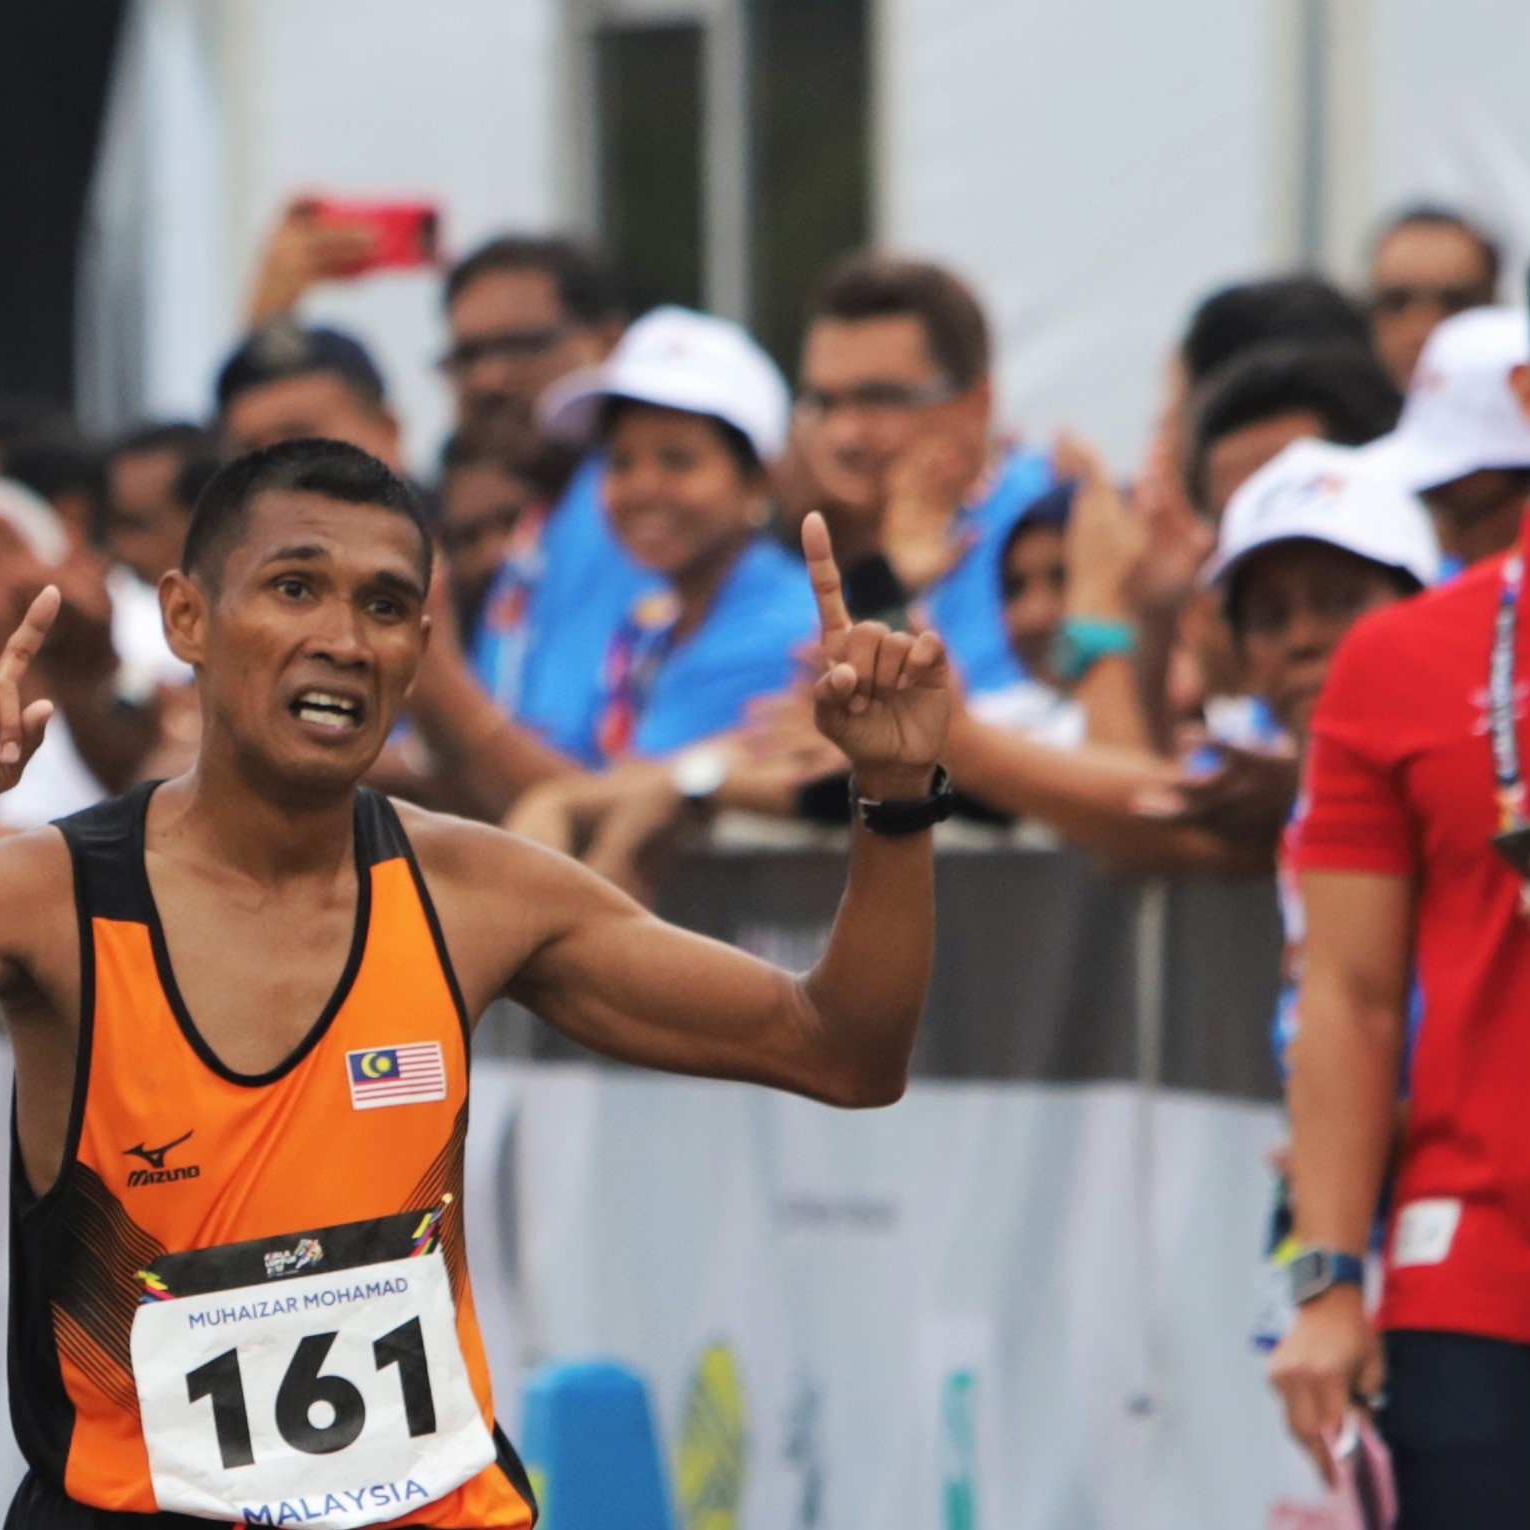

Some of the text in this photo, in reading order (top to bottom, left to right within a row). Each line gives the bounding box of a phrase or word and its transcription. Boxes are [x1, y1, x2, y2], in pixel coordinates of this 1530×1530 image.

[188, 1277, 408, 1329] MUHAIZAR MOHAMAD
[185, 1315, 437, 1469] 161
[242, 1479, 430, 1526] MALAYSIA
